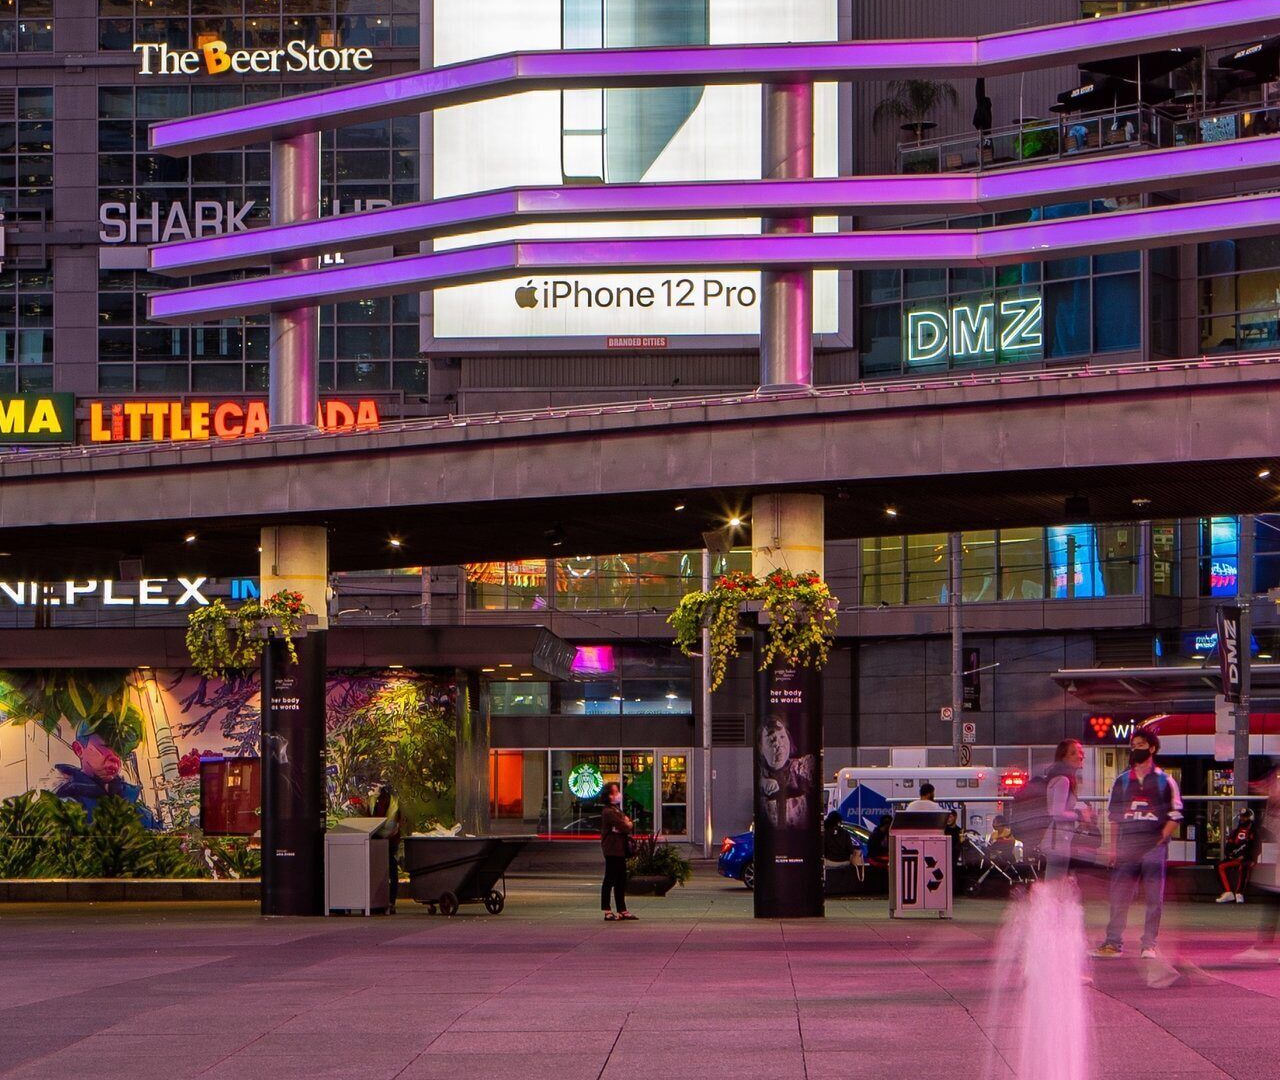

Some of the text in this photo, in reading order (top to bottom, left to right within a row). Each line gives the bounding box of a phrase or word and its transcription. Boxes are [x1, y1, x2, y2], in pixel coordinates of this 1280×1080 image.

[133, 39, 374, 75] The Beer Store
[98, 200, 257, 244] SHARK
[542, 277, 757, 310] iPhone 12 Pro
[908, 296, 1043, 363] DMZ
[607, 337, 668, 348] BRANDED CITIES
[1222, 618, 1240, 685] DMZ
[282, 697, 300, 706] body
[770, 689, 803, 698] her body
[780, 696, 803, 704] words
[279, 703, 300, 711] words
